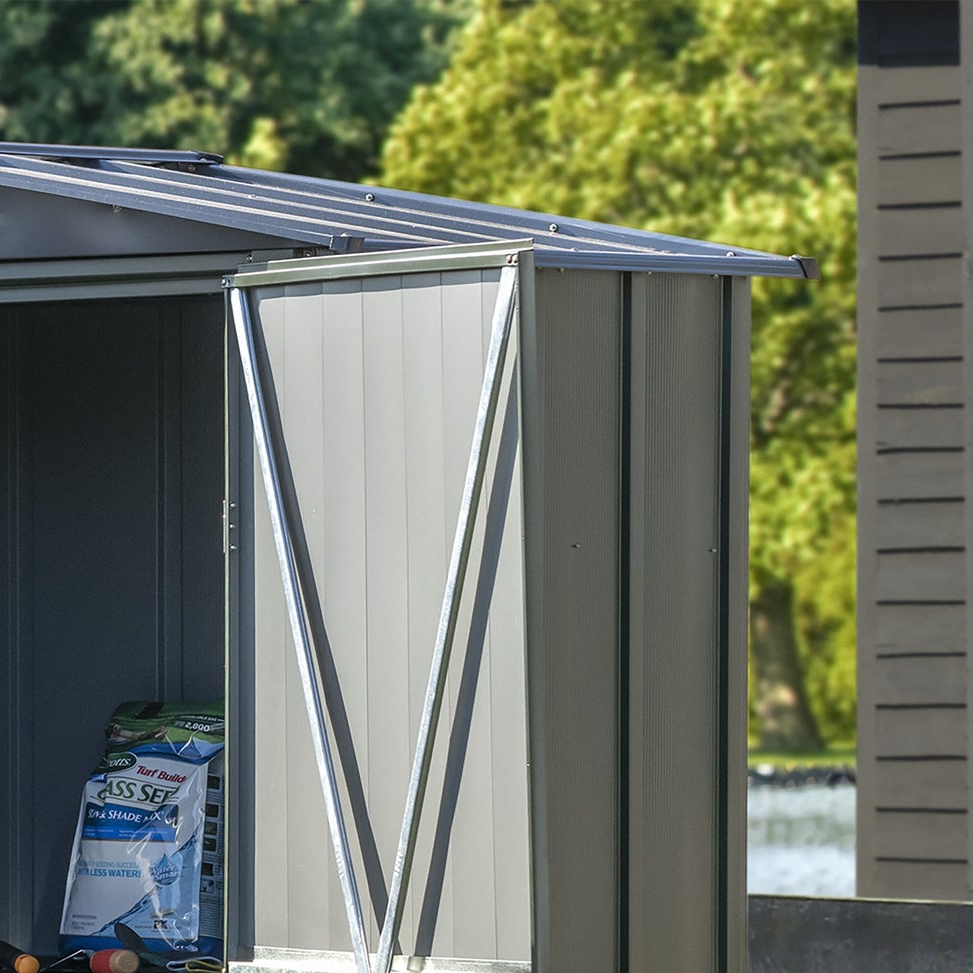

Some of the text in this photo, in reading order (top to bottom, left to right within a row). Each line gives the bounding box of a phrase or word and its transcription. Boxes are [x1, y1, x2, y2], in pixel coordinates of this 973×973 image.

[136, 765, 187, 784] Turf Build
[97, 780, 137, 800] ASS
[108, 809, 143, 823] SHADE
[90, 868, 108, 877] LESS
